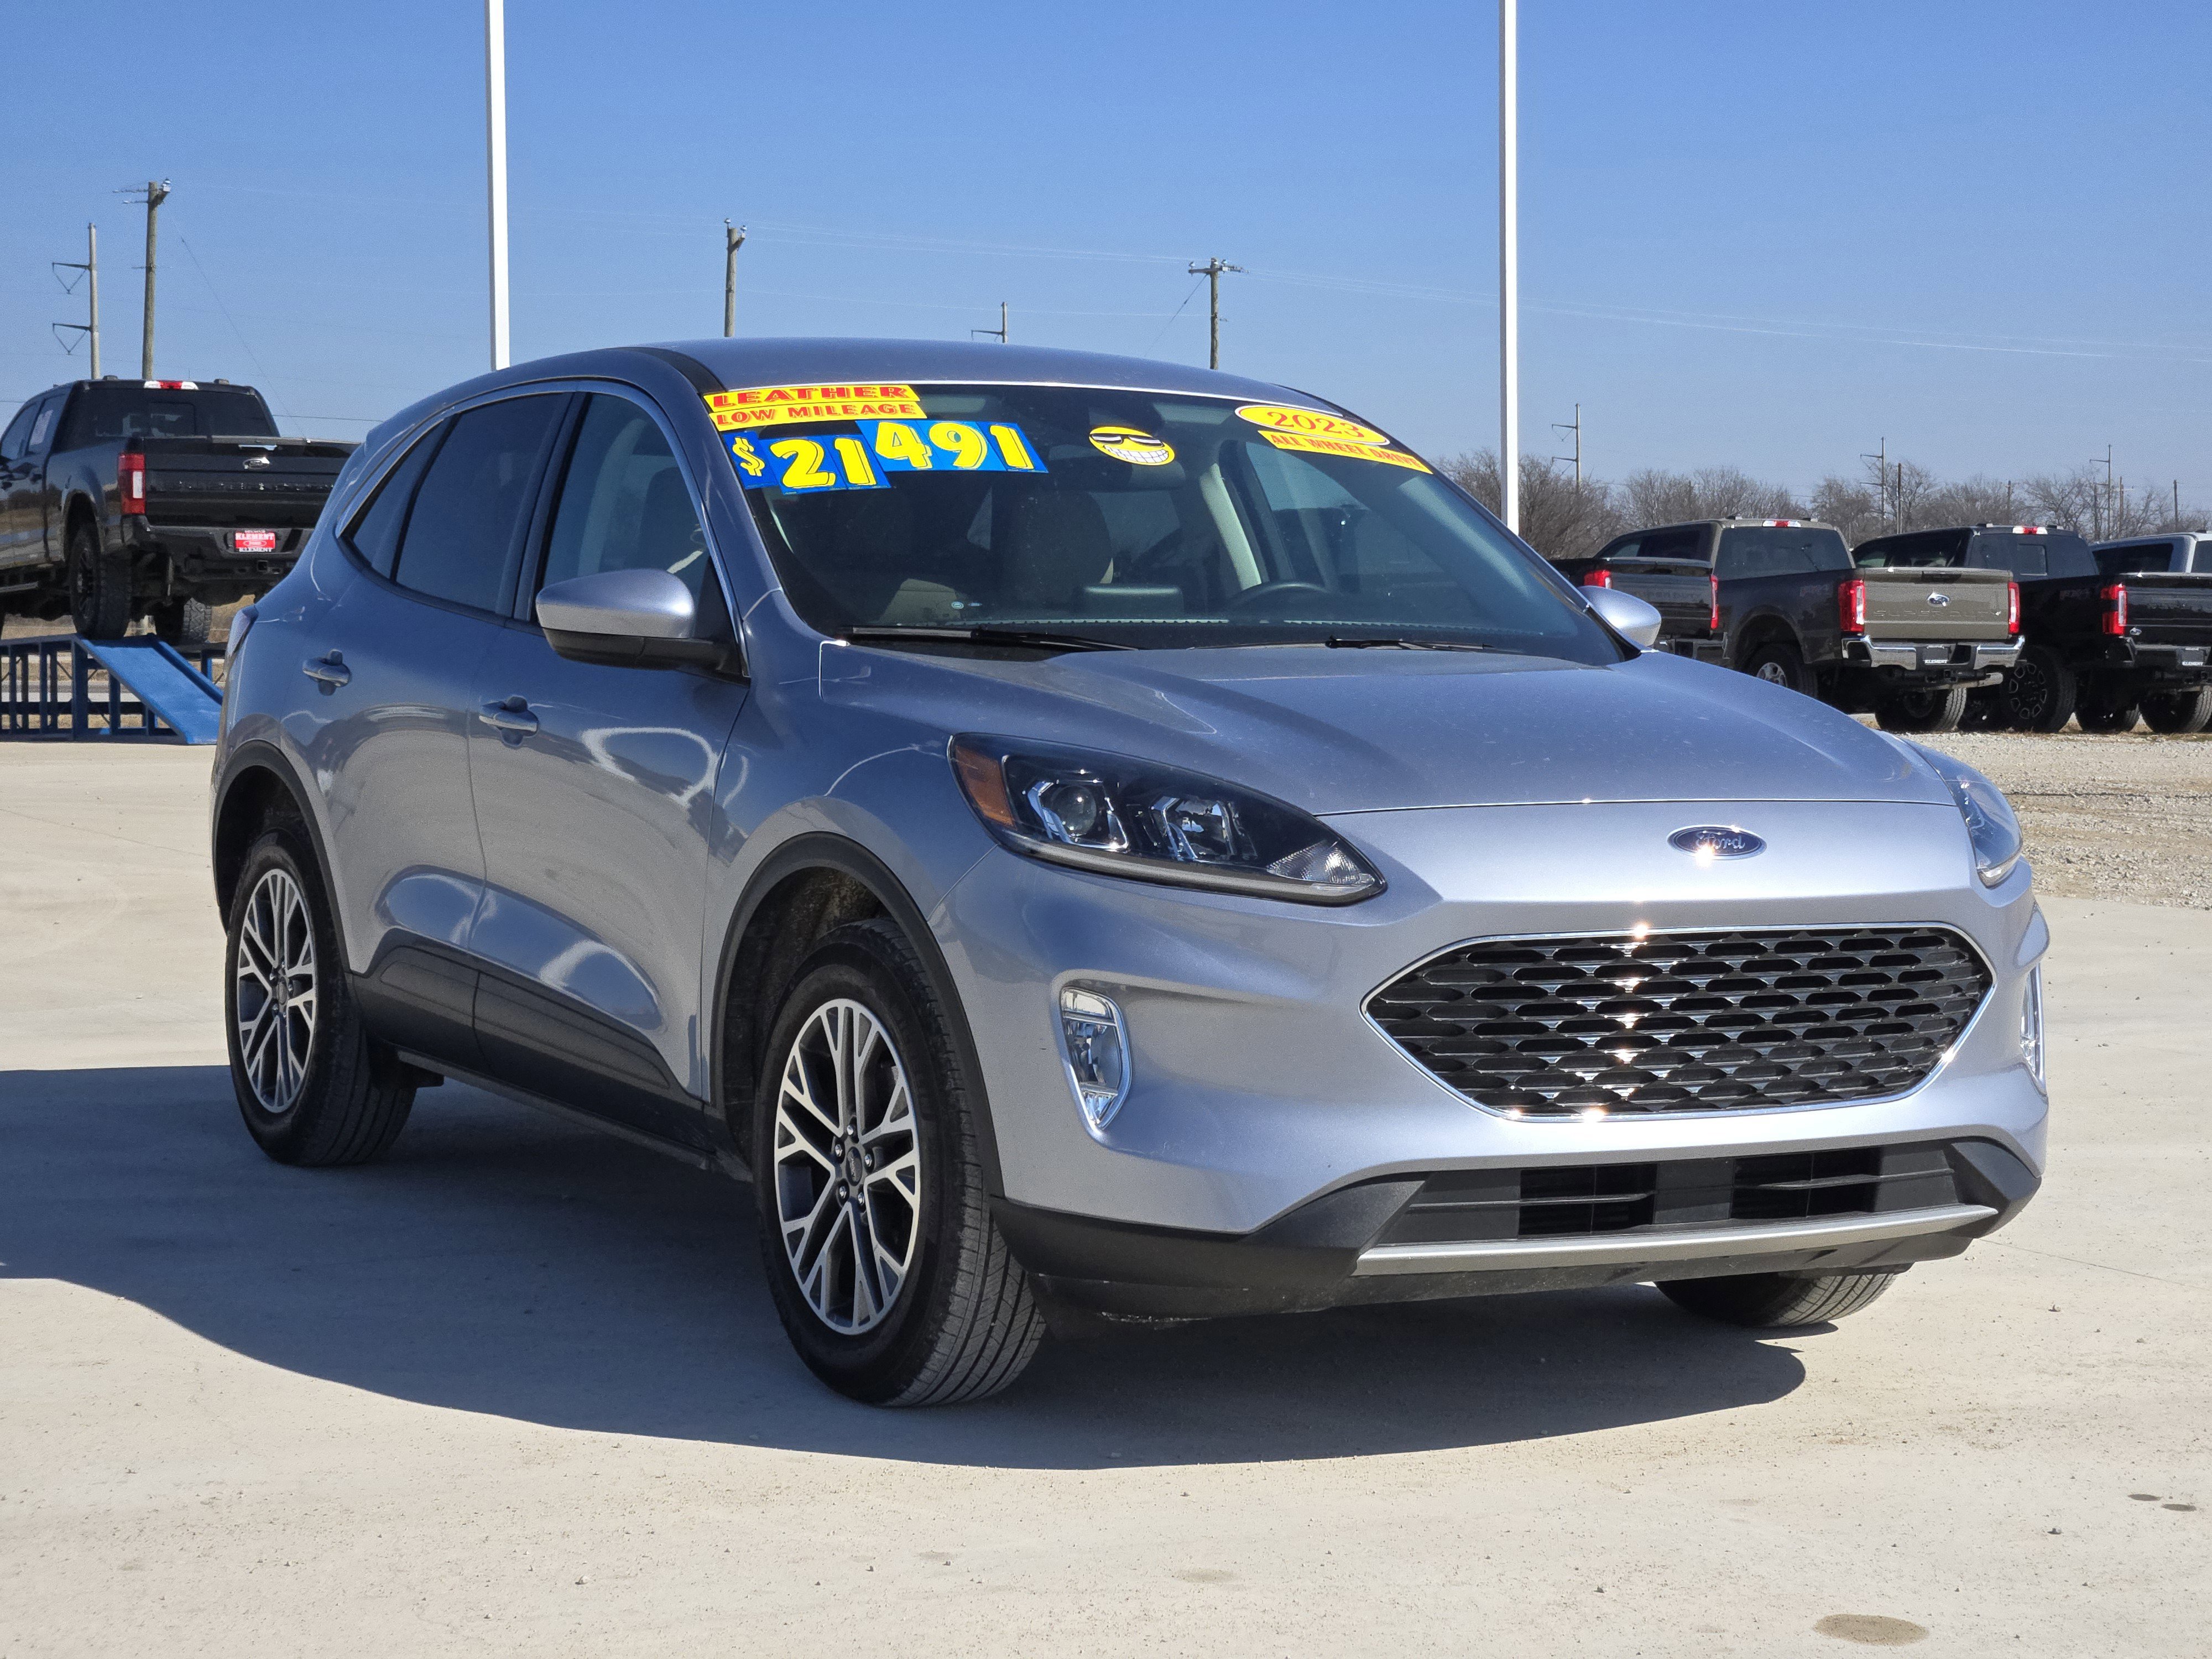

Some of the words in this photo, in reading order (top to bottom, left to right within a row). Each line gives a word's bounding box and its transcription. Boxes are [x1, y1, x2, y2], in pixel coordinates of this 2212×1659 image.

[713, 387, 909, 408] LEATHER
[717, 409, 775, 426] LOW
[787, 404, 915, 418] MILEAGE
[1267, 411, 1365, 438] 2023
[1271, 434, 1302, 446] ALL
[1305, 437, 1368, 456] WHEEL
[1368, 447, 1423, 468] DRIVE
[1695, 831, 1745, 849] Ford
